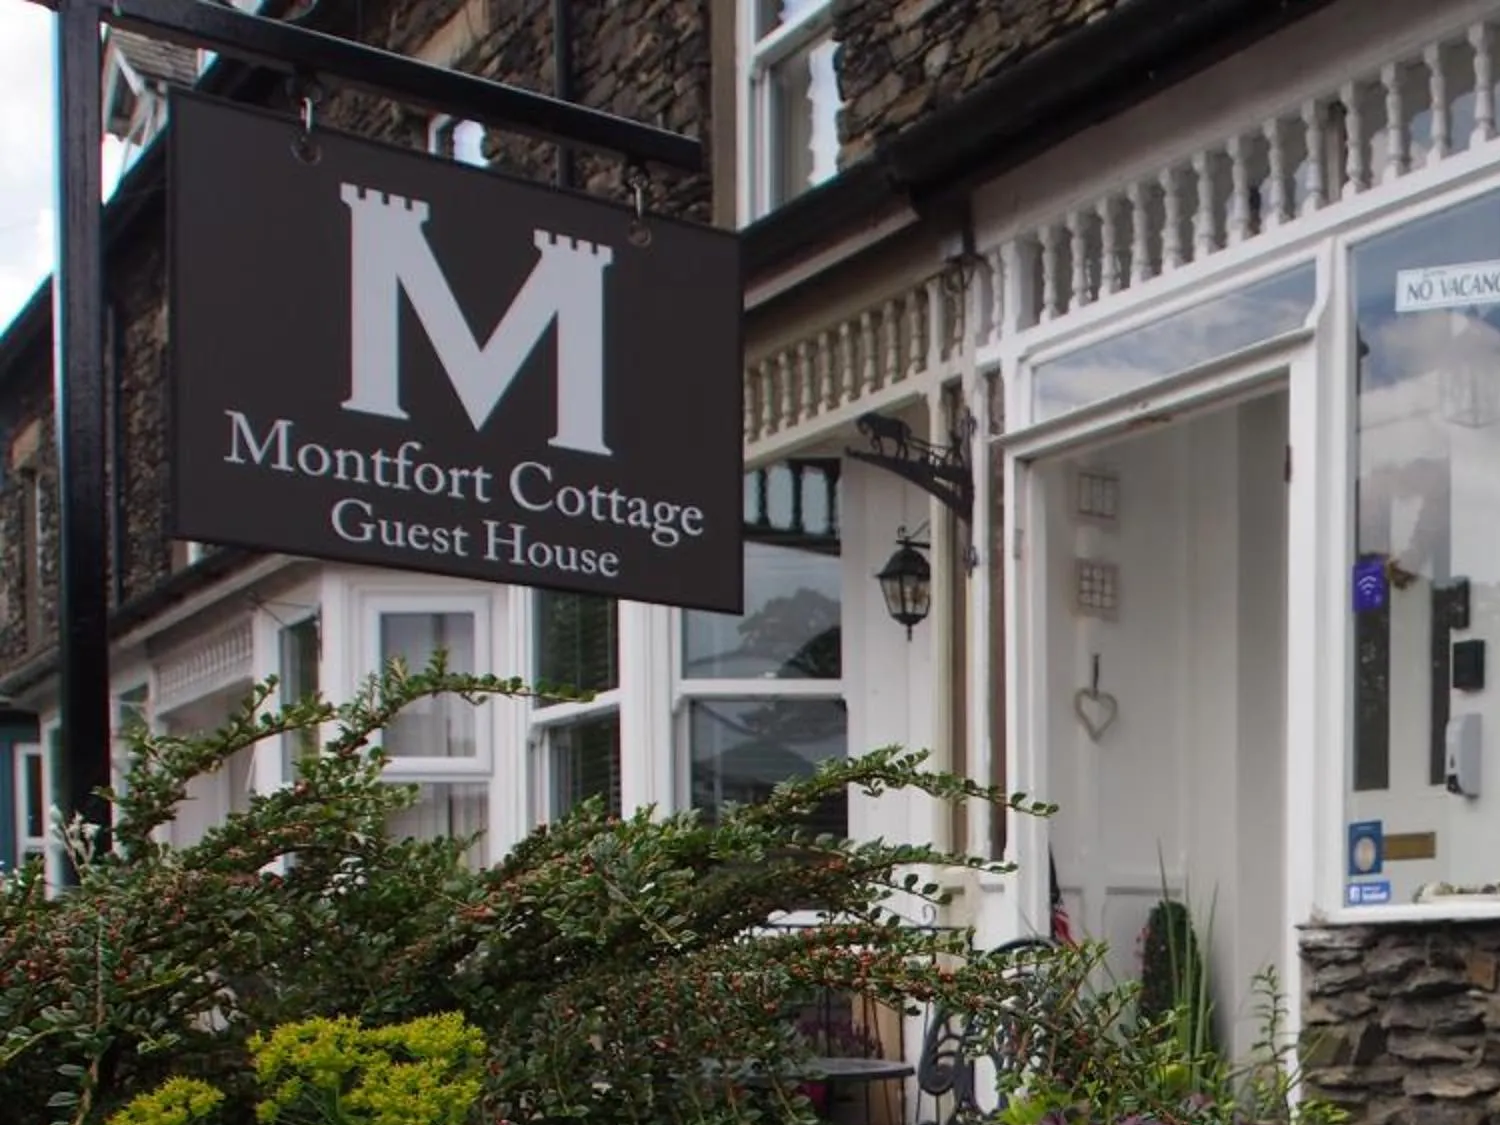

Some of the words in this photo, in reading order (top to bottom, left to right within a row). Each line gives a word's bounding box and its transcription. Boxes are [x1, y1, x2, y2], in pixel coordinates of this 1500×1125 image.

[340, 182, 613, 456] M
[1407, 280, 1433, 301] NO
[224, 410, 491, 502] Montfort
[510, 461, 705, 546] Cottage
[331, 499, 469, 557] Guest
[484, 520, 620, 577] House
